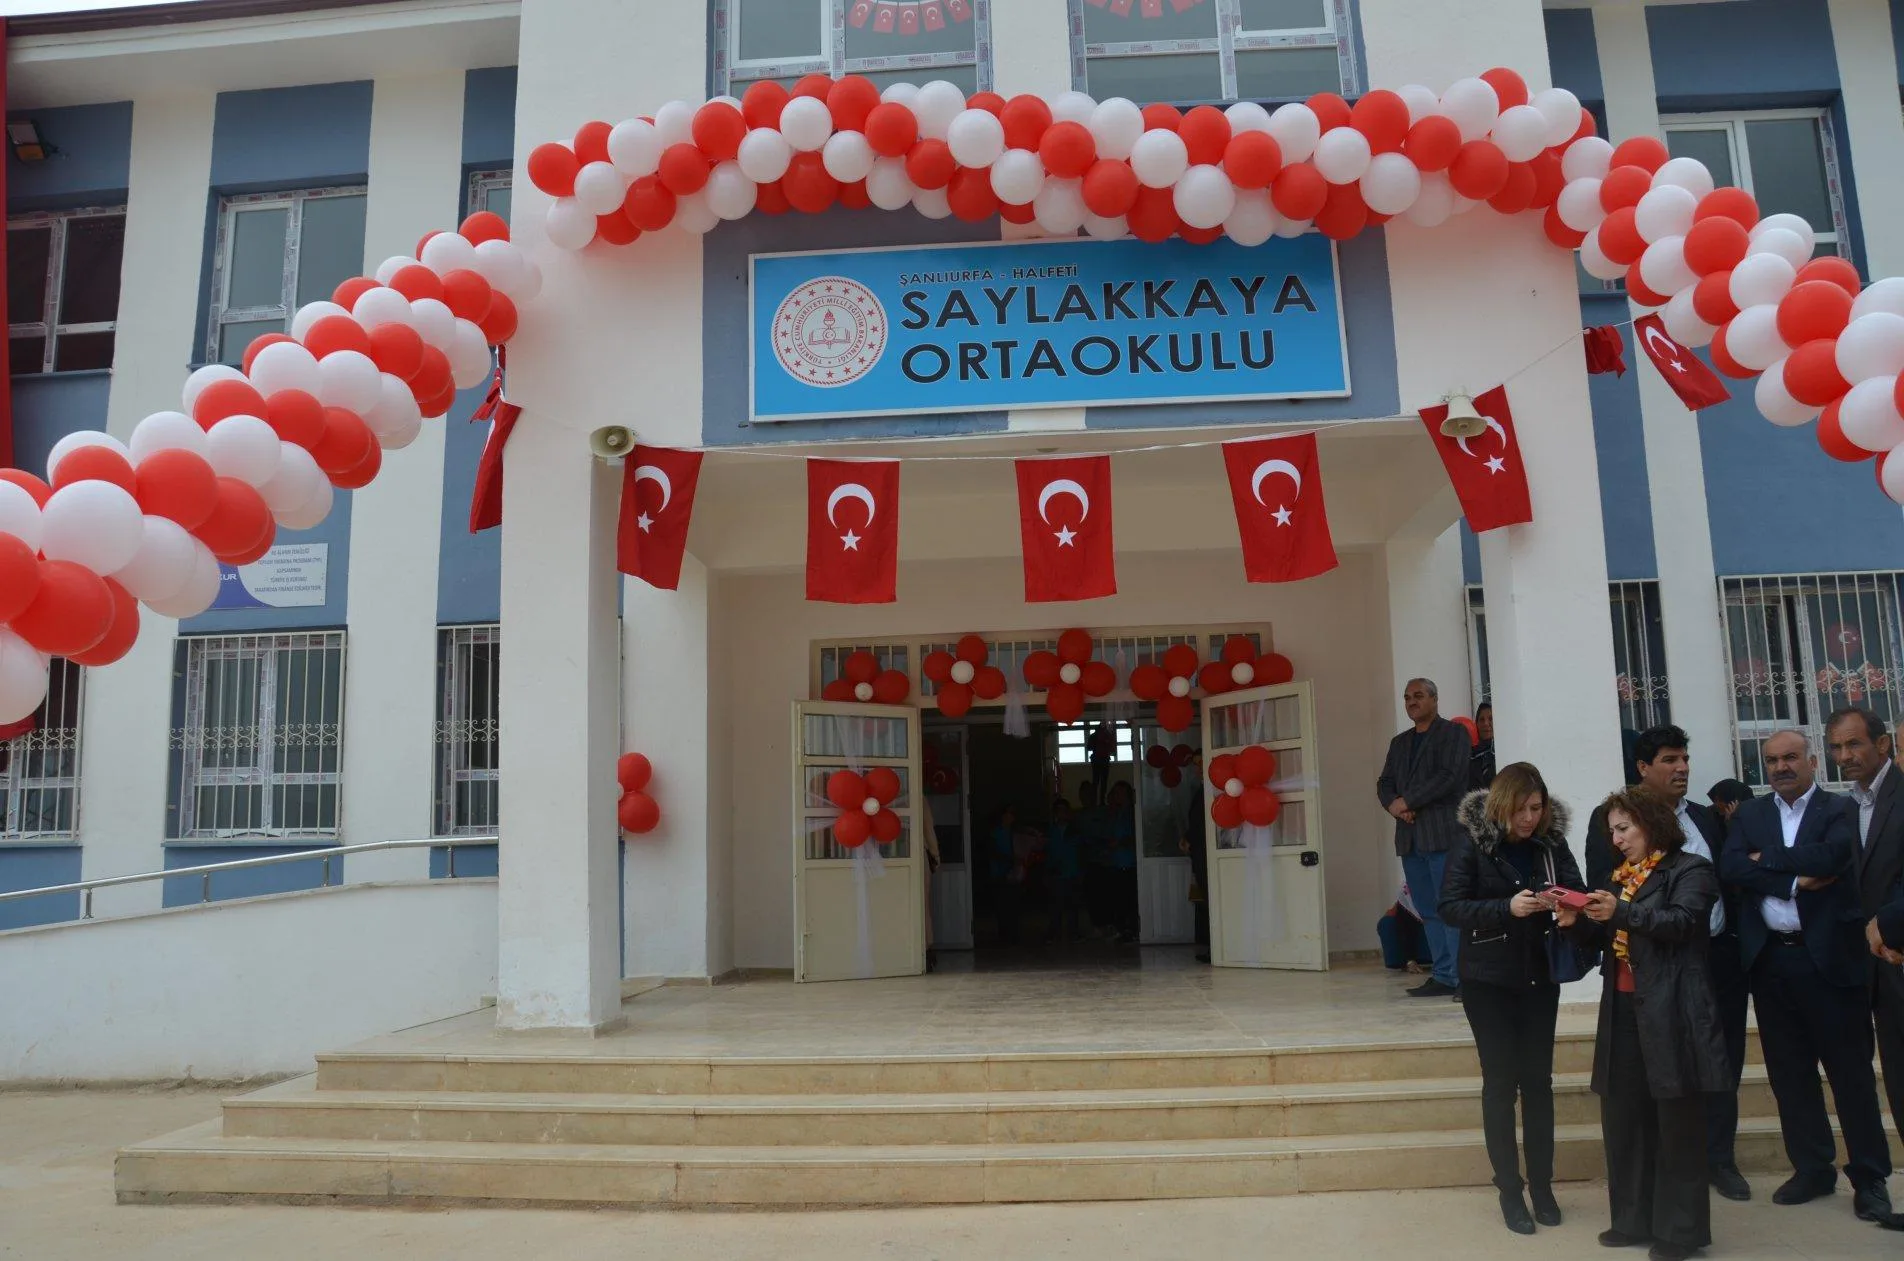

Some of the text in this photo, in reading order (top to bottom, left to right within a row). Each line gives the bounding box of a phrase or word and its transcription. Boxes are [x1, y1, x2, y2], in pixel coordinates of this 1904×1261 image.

[900, 270, 993, 286] ŞANLIURFA
[1013, 264, 1078, 279] HALFETİ
[901, 274, 1318, 329] SAYLAKKAYA
[901, 329, 1276, 384] ORTAOKULU
